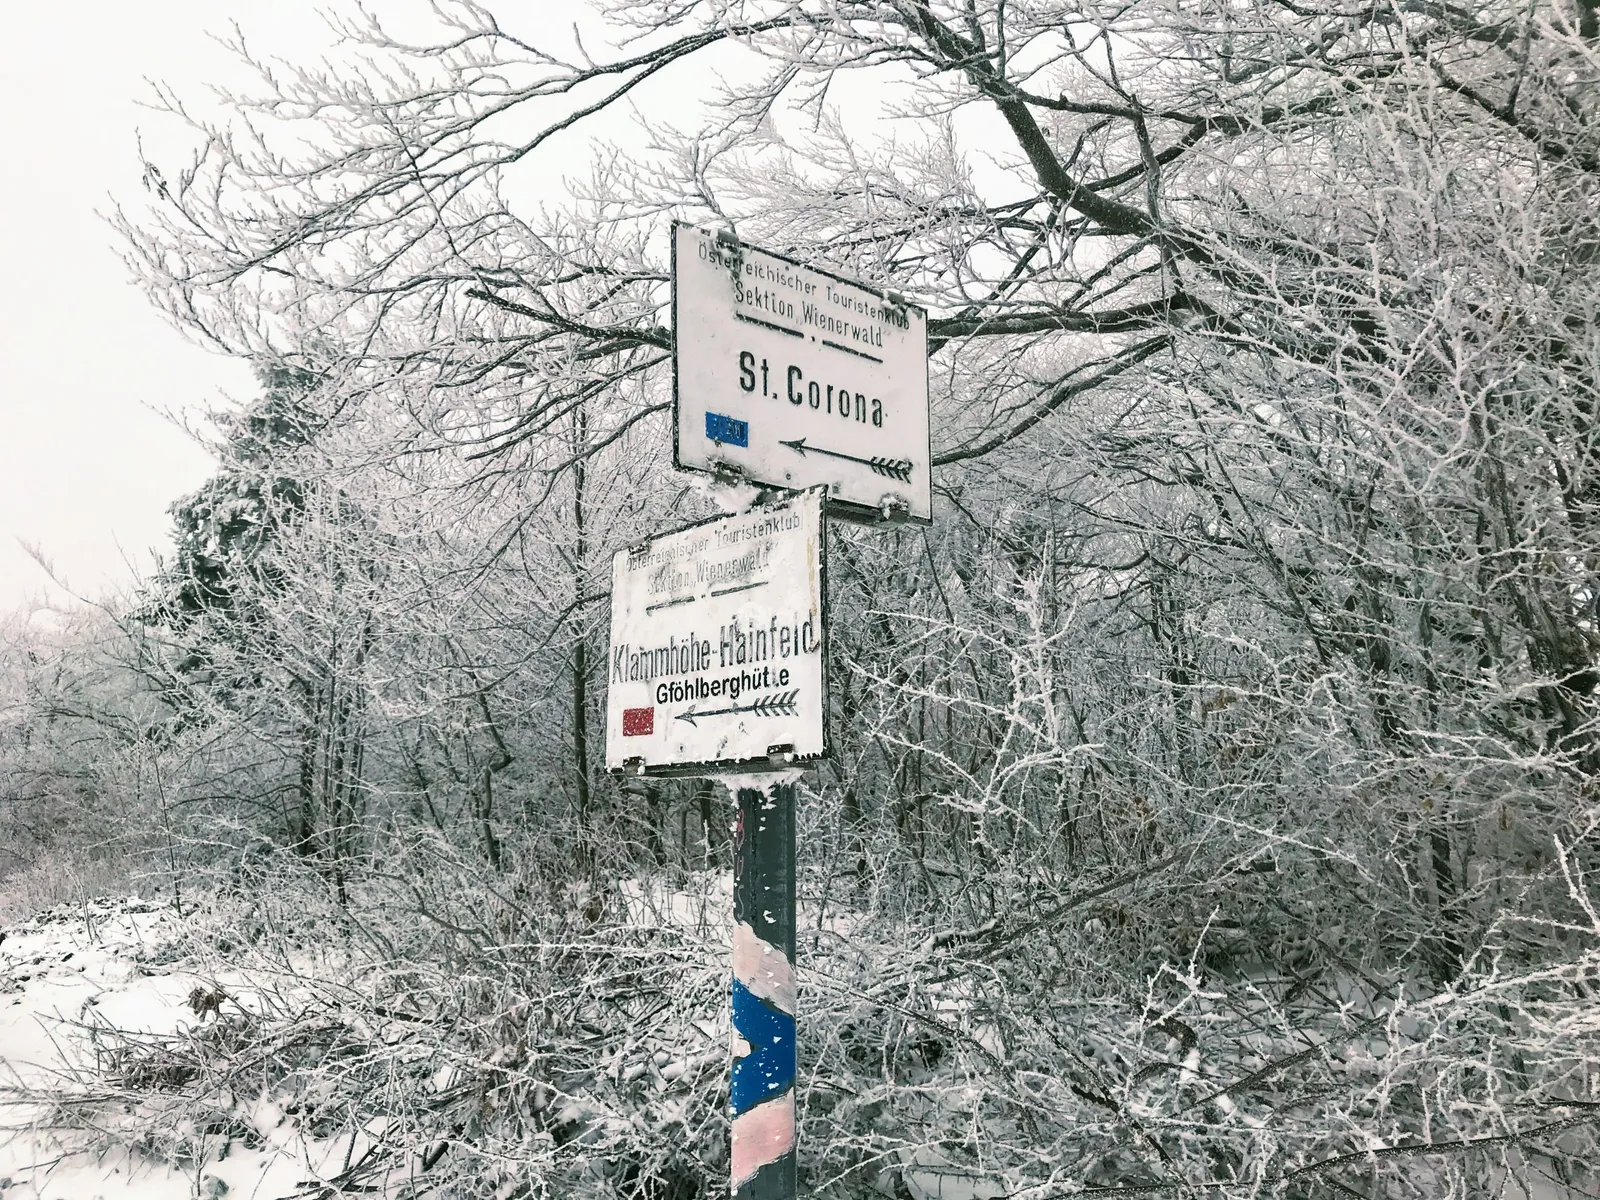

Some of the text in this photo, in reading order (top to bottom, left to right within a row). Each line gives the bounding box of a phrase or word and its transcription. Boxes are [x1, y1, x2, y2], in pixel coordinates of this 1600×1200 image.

[698, 240, 910, 331] Österreichischer Touristenklub
[735, 280, 794, 320] Sektion
[714, 514, 801, 548] Touristenklub
